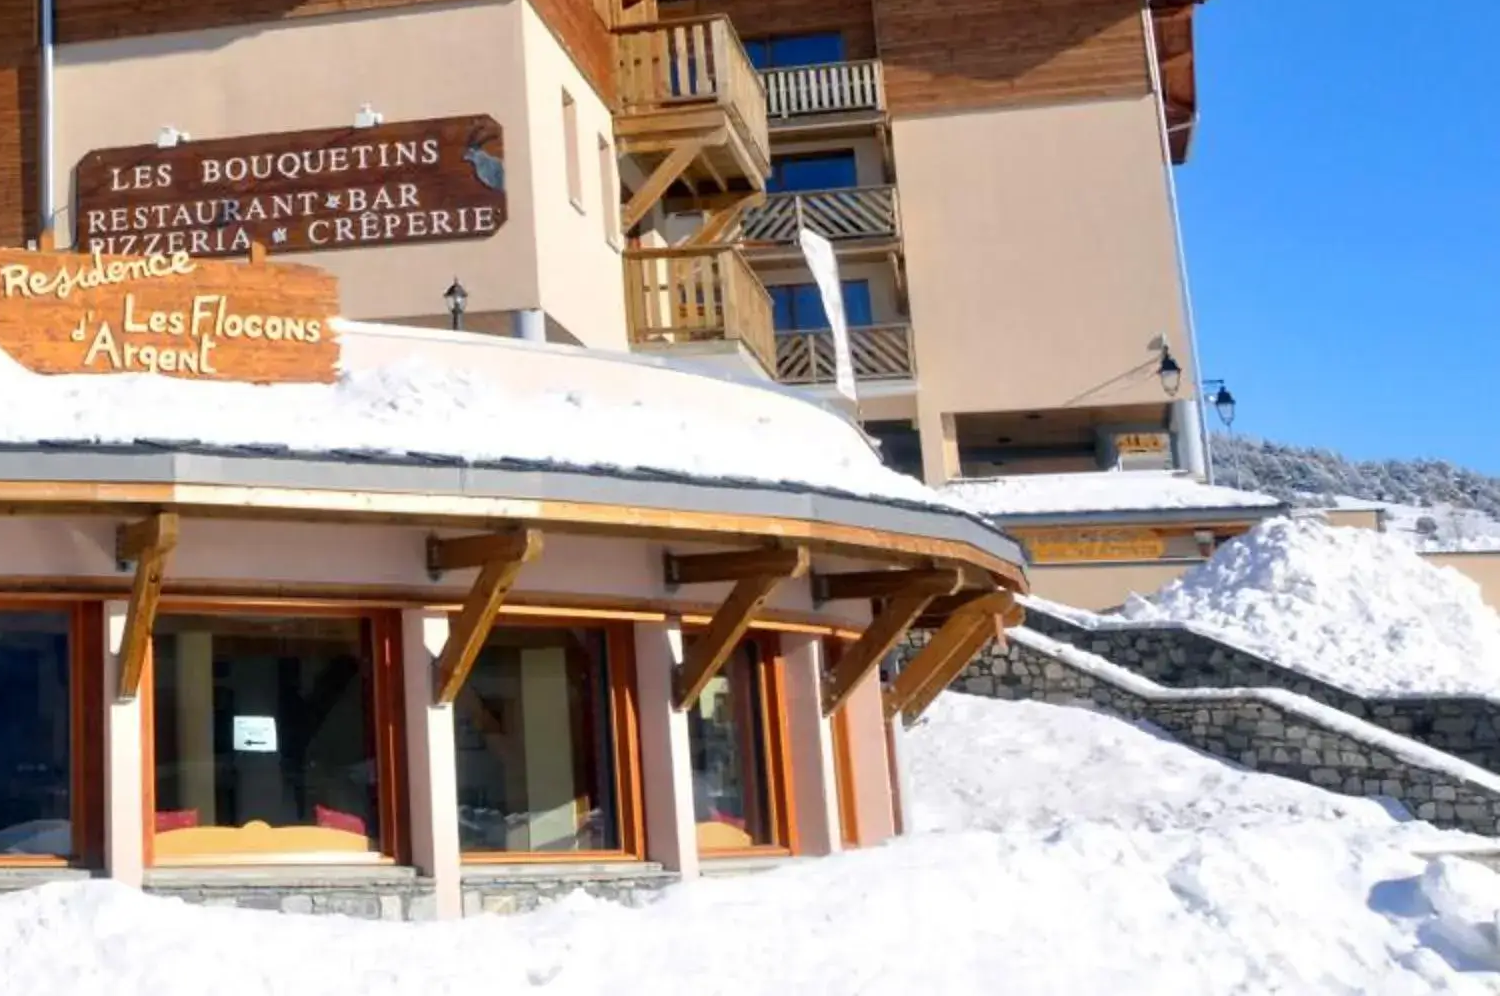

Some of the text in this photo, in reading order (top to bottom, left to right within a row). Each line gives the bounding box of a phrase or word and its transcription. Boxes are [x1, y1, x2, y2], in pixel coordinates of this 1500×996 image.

[111, 139, 439, 192] LES BOUQUETINS
[88, 182, 420, 233] RESTAURANT BAR
[89, 206, 496, 256] PIZZERIA CRÊPERIE
[0, 244, 197, 298] Residence
[124, 293, 322, 343] Les Flocons
